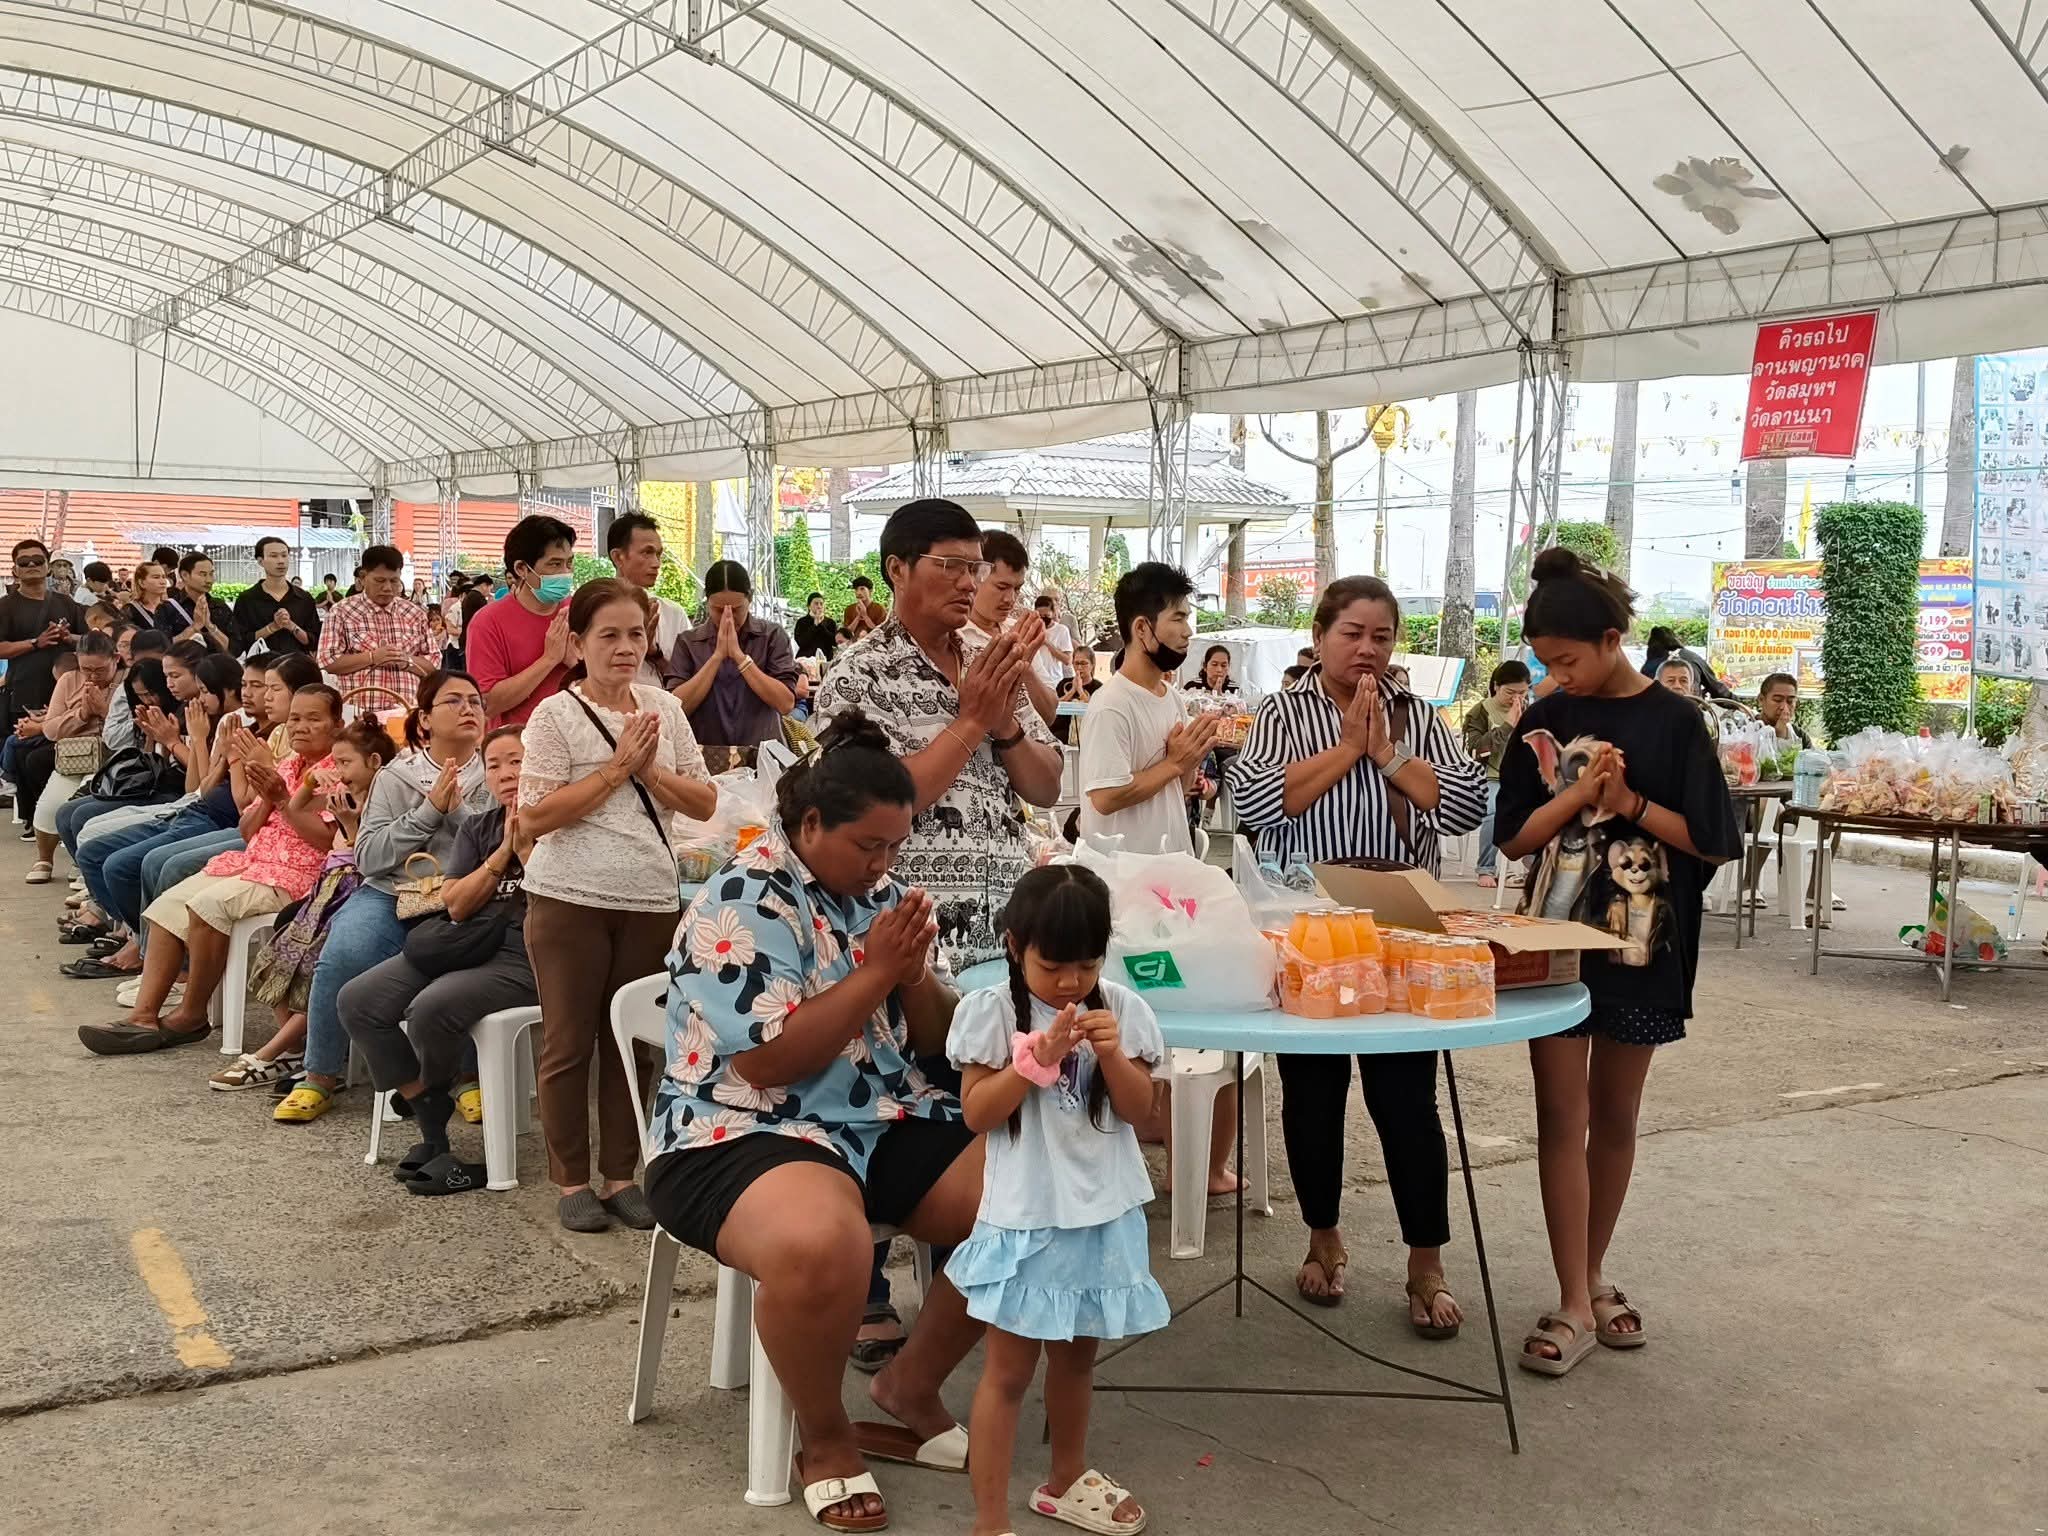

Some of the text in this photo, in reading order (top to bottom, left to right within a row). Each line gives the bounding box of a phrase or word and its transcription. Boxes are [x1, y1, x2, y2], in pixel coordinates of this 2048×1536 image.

[1779, 321, 1849, 349] คิวรถไป
[1753, 352, 1865, 377] ลานพญานาค
[1751, 407, 1832, 428] วัดลานนา
